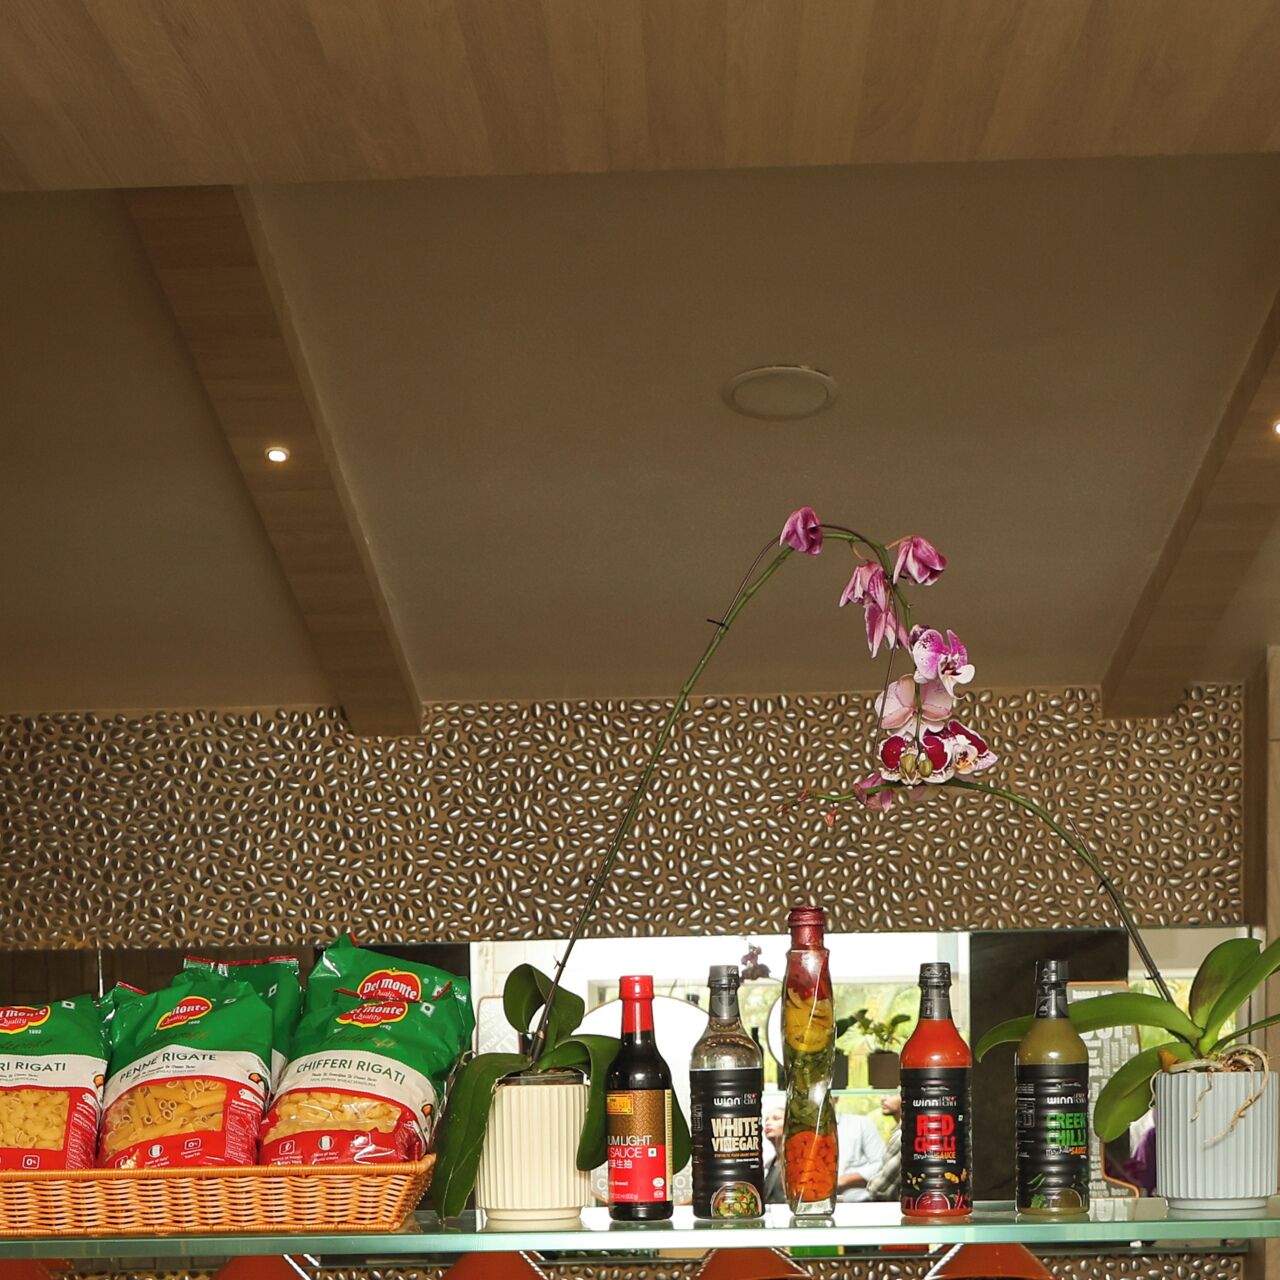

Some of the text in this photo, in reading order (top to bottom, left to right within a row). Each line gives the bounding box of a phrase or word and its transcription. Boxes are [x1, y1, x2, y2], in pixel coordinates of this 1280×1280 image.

[364, 978, 417, 1000] Del Monte
[6, 1006, 46, 1017] Monte
[16, 1062, 67, 1072] RIGATI
[120, 1056, 158, 1082] PENNE
[162, 1052, 217, 1062] RIGATE
[296, 1058, 353, 1074] CHIFFERI
[356, 1060, 406, 1085] RIGATI
[710, 1116, 759, 1137] WHITE
[915, 1114, 954, 1136] RED
[621, 1135, 652, 1146] LIGHT
[711, 1137, 759, 1152] VINEGAR
[914, 1137, 956, 1153] CHILLI
[609, 1147, 642, 1158] SAUCE
